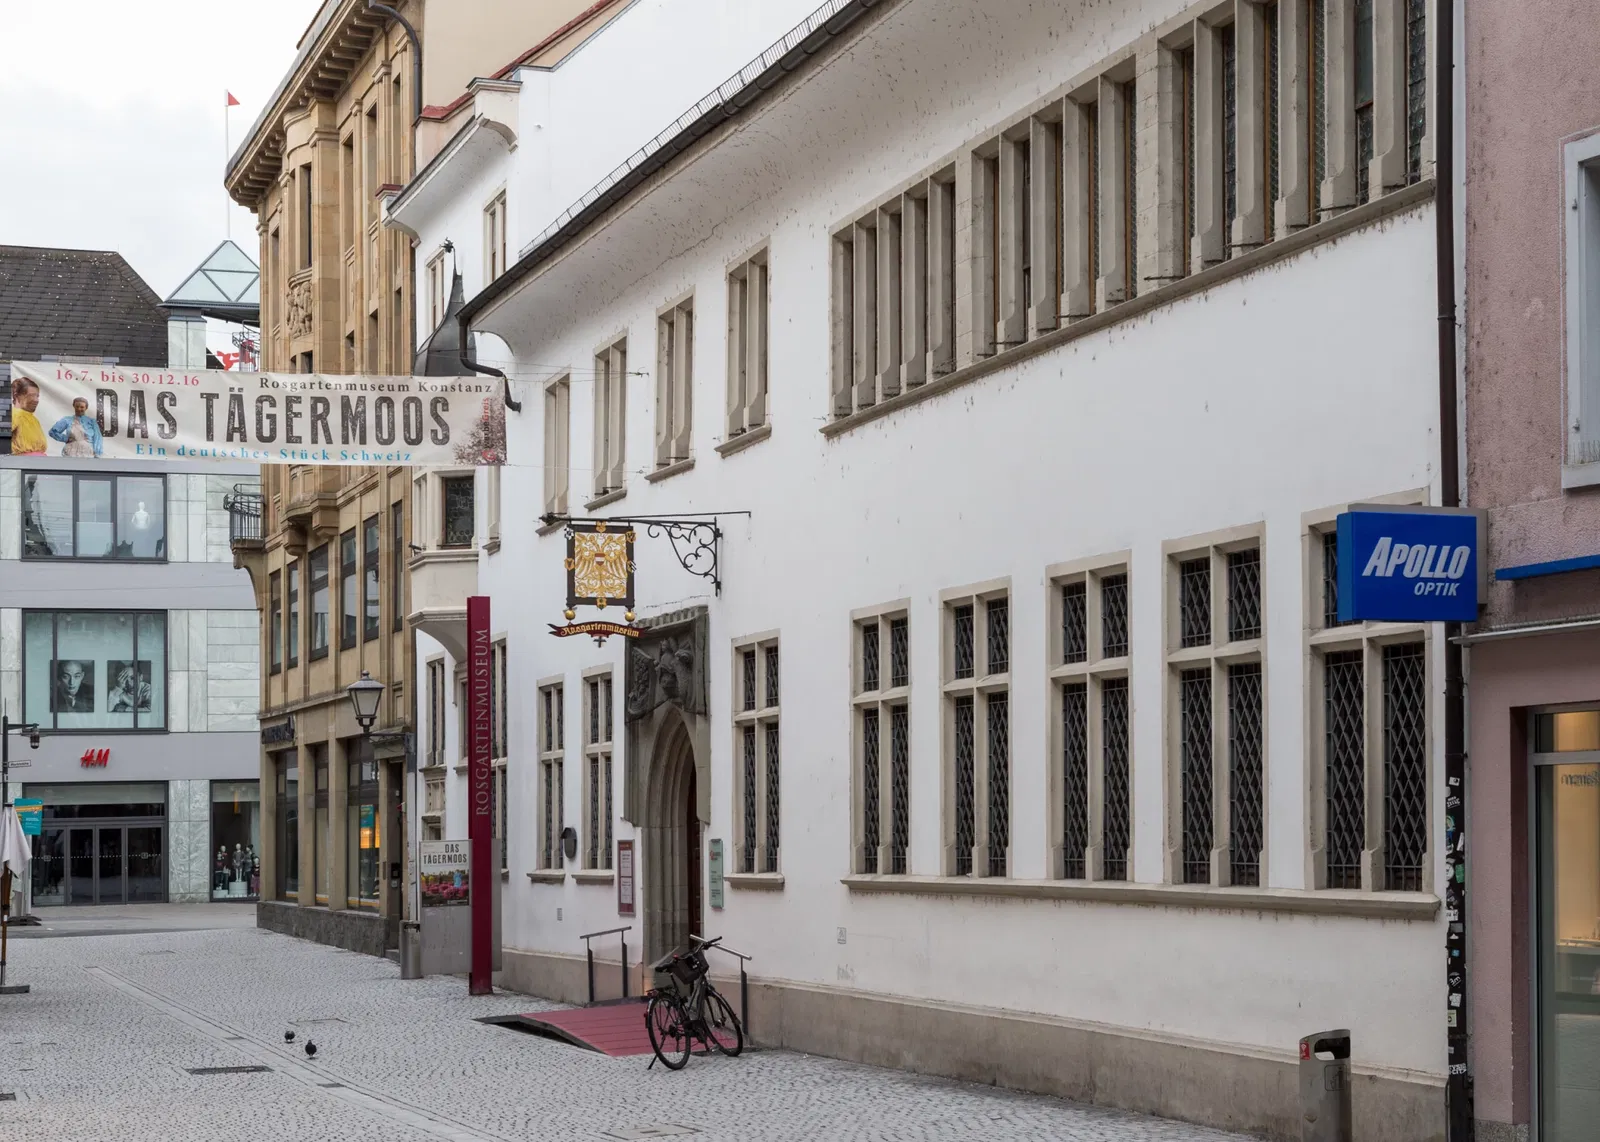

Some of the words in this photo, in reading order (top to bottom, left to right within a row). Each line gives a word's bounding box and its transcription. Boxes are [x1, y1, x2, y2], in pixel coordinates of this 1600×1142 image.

[56, 369, 93, 382] 16.7.
[101, 371, 125, 383] bis
[131, 372, 199, 386] 30.12.16
[259, 377, 410, 392] Rosgartenmuseum
[418, 381, 492, 393] Konstanz
[95, 388, 178, 440] DAS
[200, 387, 450, 446] TÄGERMOOS
[136, 443, 166, 455] Ein
[177, 445, 269, 459] deutsches
[280, 448, 330, 460] Stück
[340, 449, 411, 461] Schweiz
[1362, 536, 1471, 580] APOLLO
[1413, 581, 1461, 597] OPTIK
[475, 628, 489, 816] ROSGARTENMUSEUM
[80, 748, 110, 769] H&M
[444, 843, 460, 853] DAS
